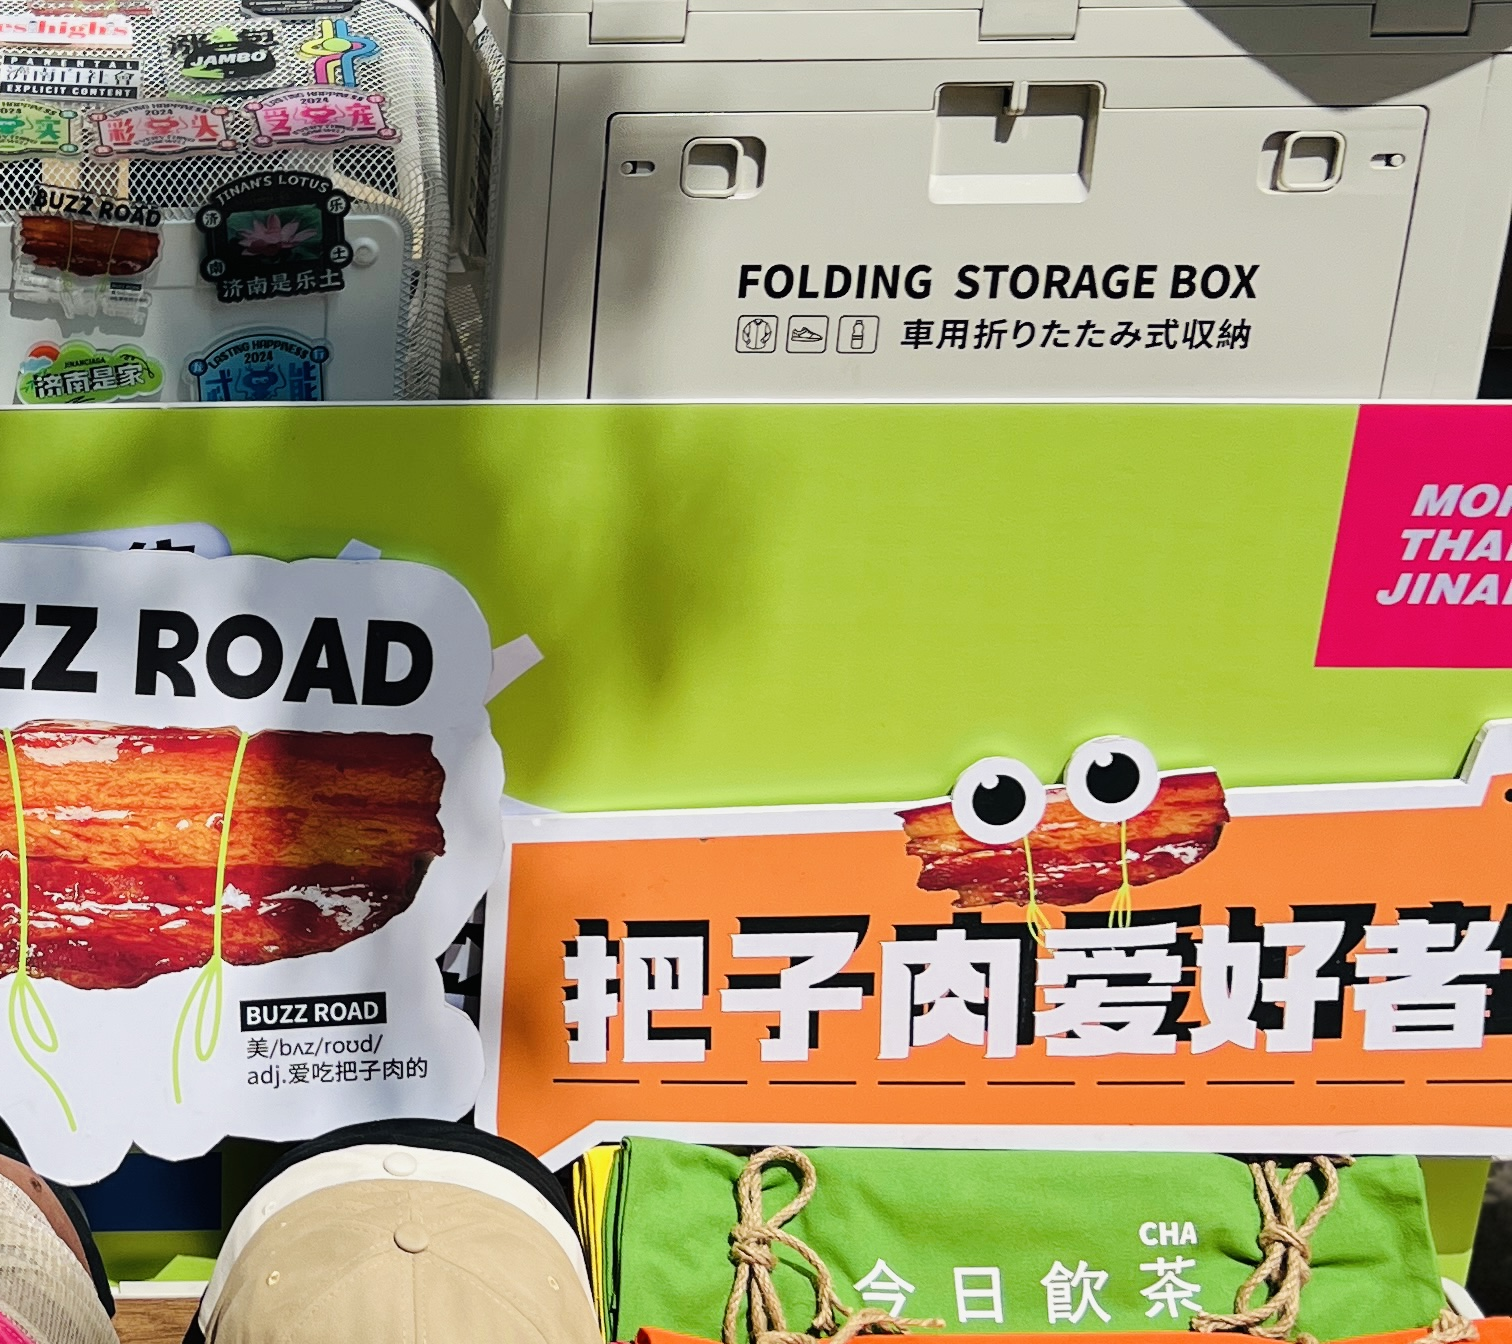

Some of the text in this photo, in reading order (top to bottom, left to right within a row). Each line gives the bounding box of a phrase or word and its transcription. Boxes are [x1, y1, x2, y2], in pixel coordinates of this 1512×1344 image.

[10, 56, 133, 69] PARENTAL
[6, 84, 67, 95] EXPLICIT
[300, 97, 330, 105] 2024
[216, 174, 331, 206] JINAN'S LOTUS
[33, 186, 162, 228] BUZZ ROAD
[222, 269, 342, 298] 济南是乐土
[737, 263, 1261, 301] FOLDING STORAGE BOX
[900, 317, 1252, 353] 車用折りたたみ式収納
[208, 342, 251, 370] LASTING
[251, 339, 310, 361] HAPPINESS
[244, 350, 274, 364] 2024
[34, 364, 144, 400] 济南是家
[1401, 529, 1512, 561] THA
[1376, 573, 1512, 606] JINA
[135, 609, 435, 708] ROAD
[560, 912, 1506, 1064] 把子肉爱好者
[246, 1000, 379, 1026] BUZZ ROAD
[1138, 1221, 1199, 1247] CHA
[853, 1256, 1204, 1325] 今日飲茶
